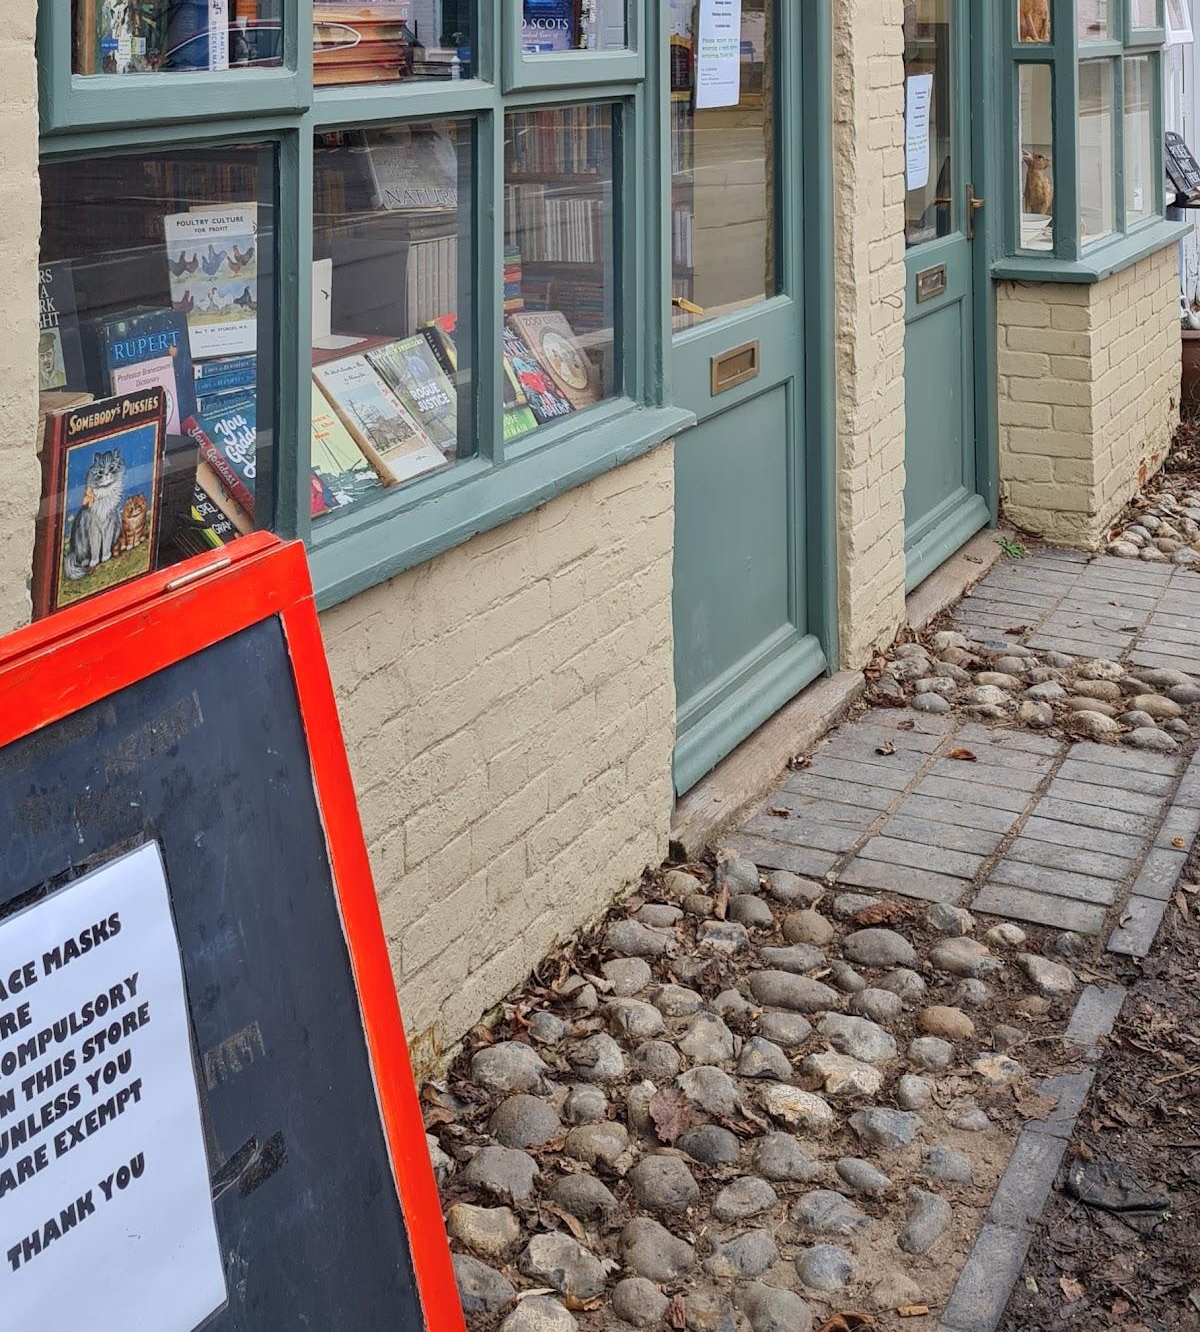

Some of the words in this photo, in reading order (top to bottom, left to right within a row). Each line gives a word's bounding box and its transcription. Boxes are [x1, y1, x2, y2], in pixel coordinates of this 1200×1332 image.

[531, 18, 569, 29] SCOTS
[176, 218, 209, 228] POULTRY
[211, 216, 244, 225] CULTURE
[208, 225, 229, 233] PROFIT
[522, 316, 542, 327] ZOO
[114, 330, 180, 360] RUPERT
[118, 371, 141, 383] Professor
[409, 382, 441, 401] ROGUE
[416, 392, 451, 413] JUSTICE
[121, 396, 159, 419] PUSSIES
[186, 426, 206, 448] You
[214, 414, 247, 446] You
[0, 960, 38, 1002] ACE
[41, 911, 121, 977] MASKS
[0, 1001, 32, 1042] RE
[0, 971, 139, 1079] OMPULSORY
[0, 1088, 16, 1119] N
[21, 1049, 77, 1102] THIS
[82, 1001, 151, 1064] STORE
[0, 1083, 81, 1159] UNLESS
[86, 1048, 132, 1097] YOU
[0, 1143, 49, 1200] ARE
[53, 1077, 143, 1159] EXEMPT
[7, 1189, 96, 1273] THANK
[98, 1151, 145, 1202] YOU
